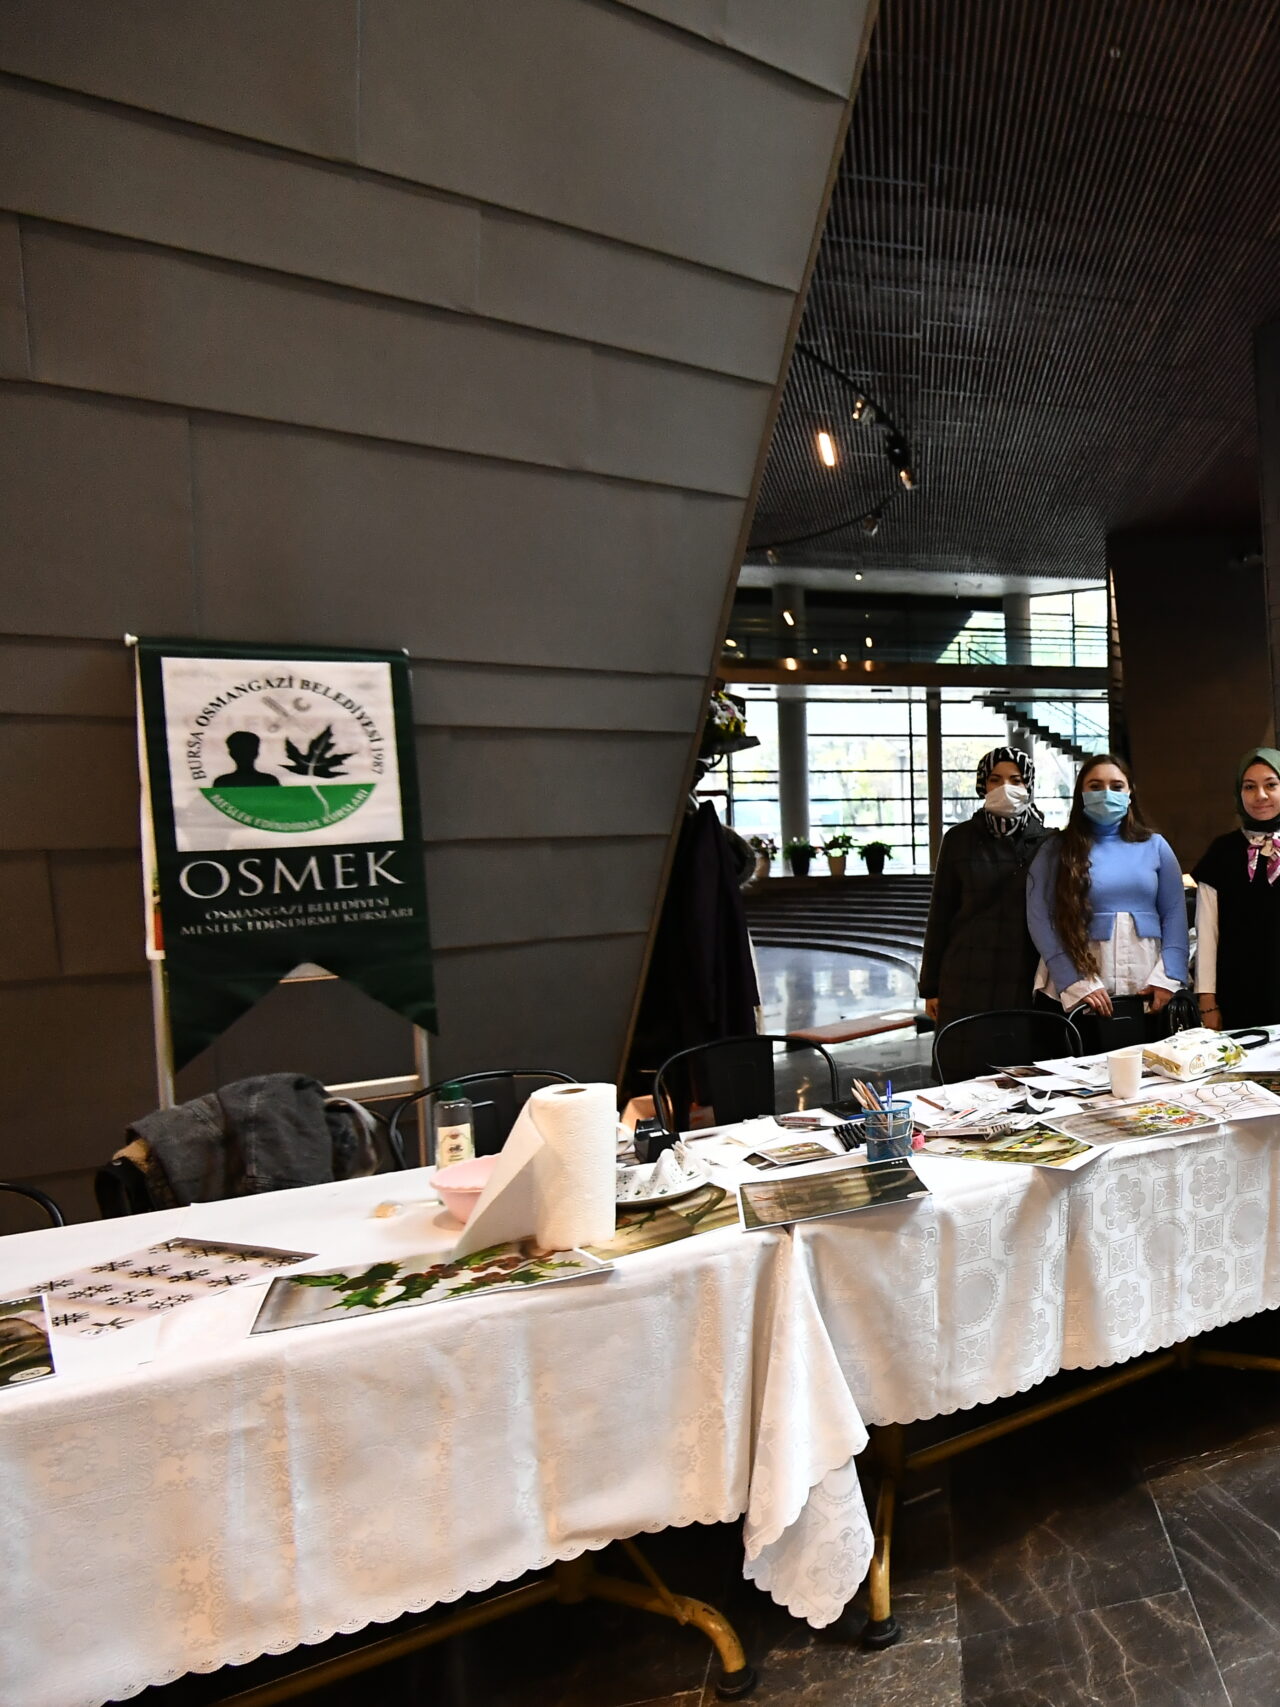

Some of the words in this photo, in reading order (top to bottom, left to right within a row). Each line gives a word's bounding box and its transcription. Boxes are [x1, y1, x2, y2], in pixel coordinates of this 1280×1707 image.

[195, 674, 293, 727] OSMANGAZİ
[299, 679, 384, 743] BELEDİYESİ
[187, 731, 207, 780] BURSA
[371, 748, 384, 775] 1987
[179, 850, 406, 899] OSMEK
